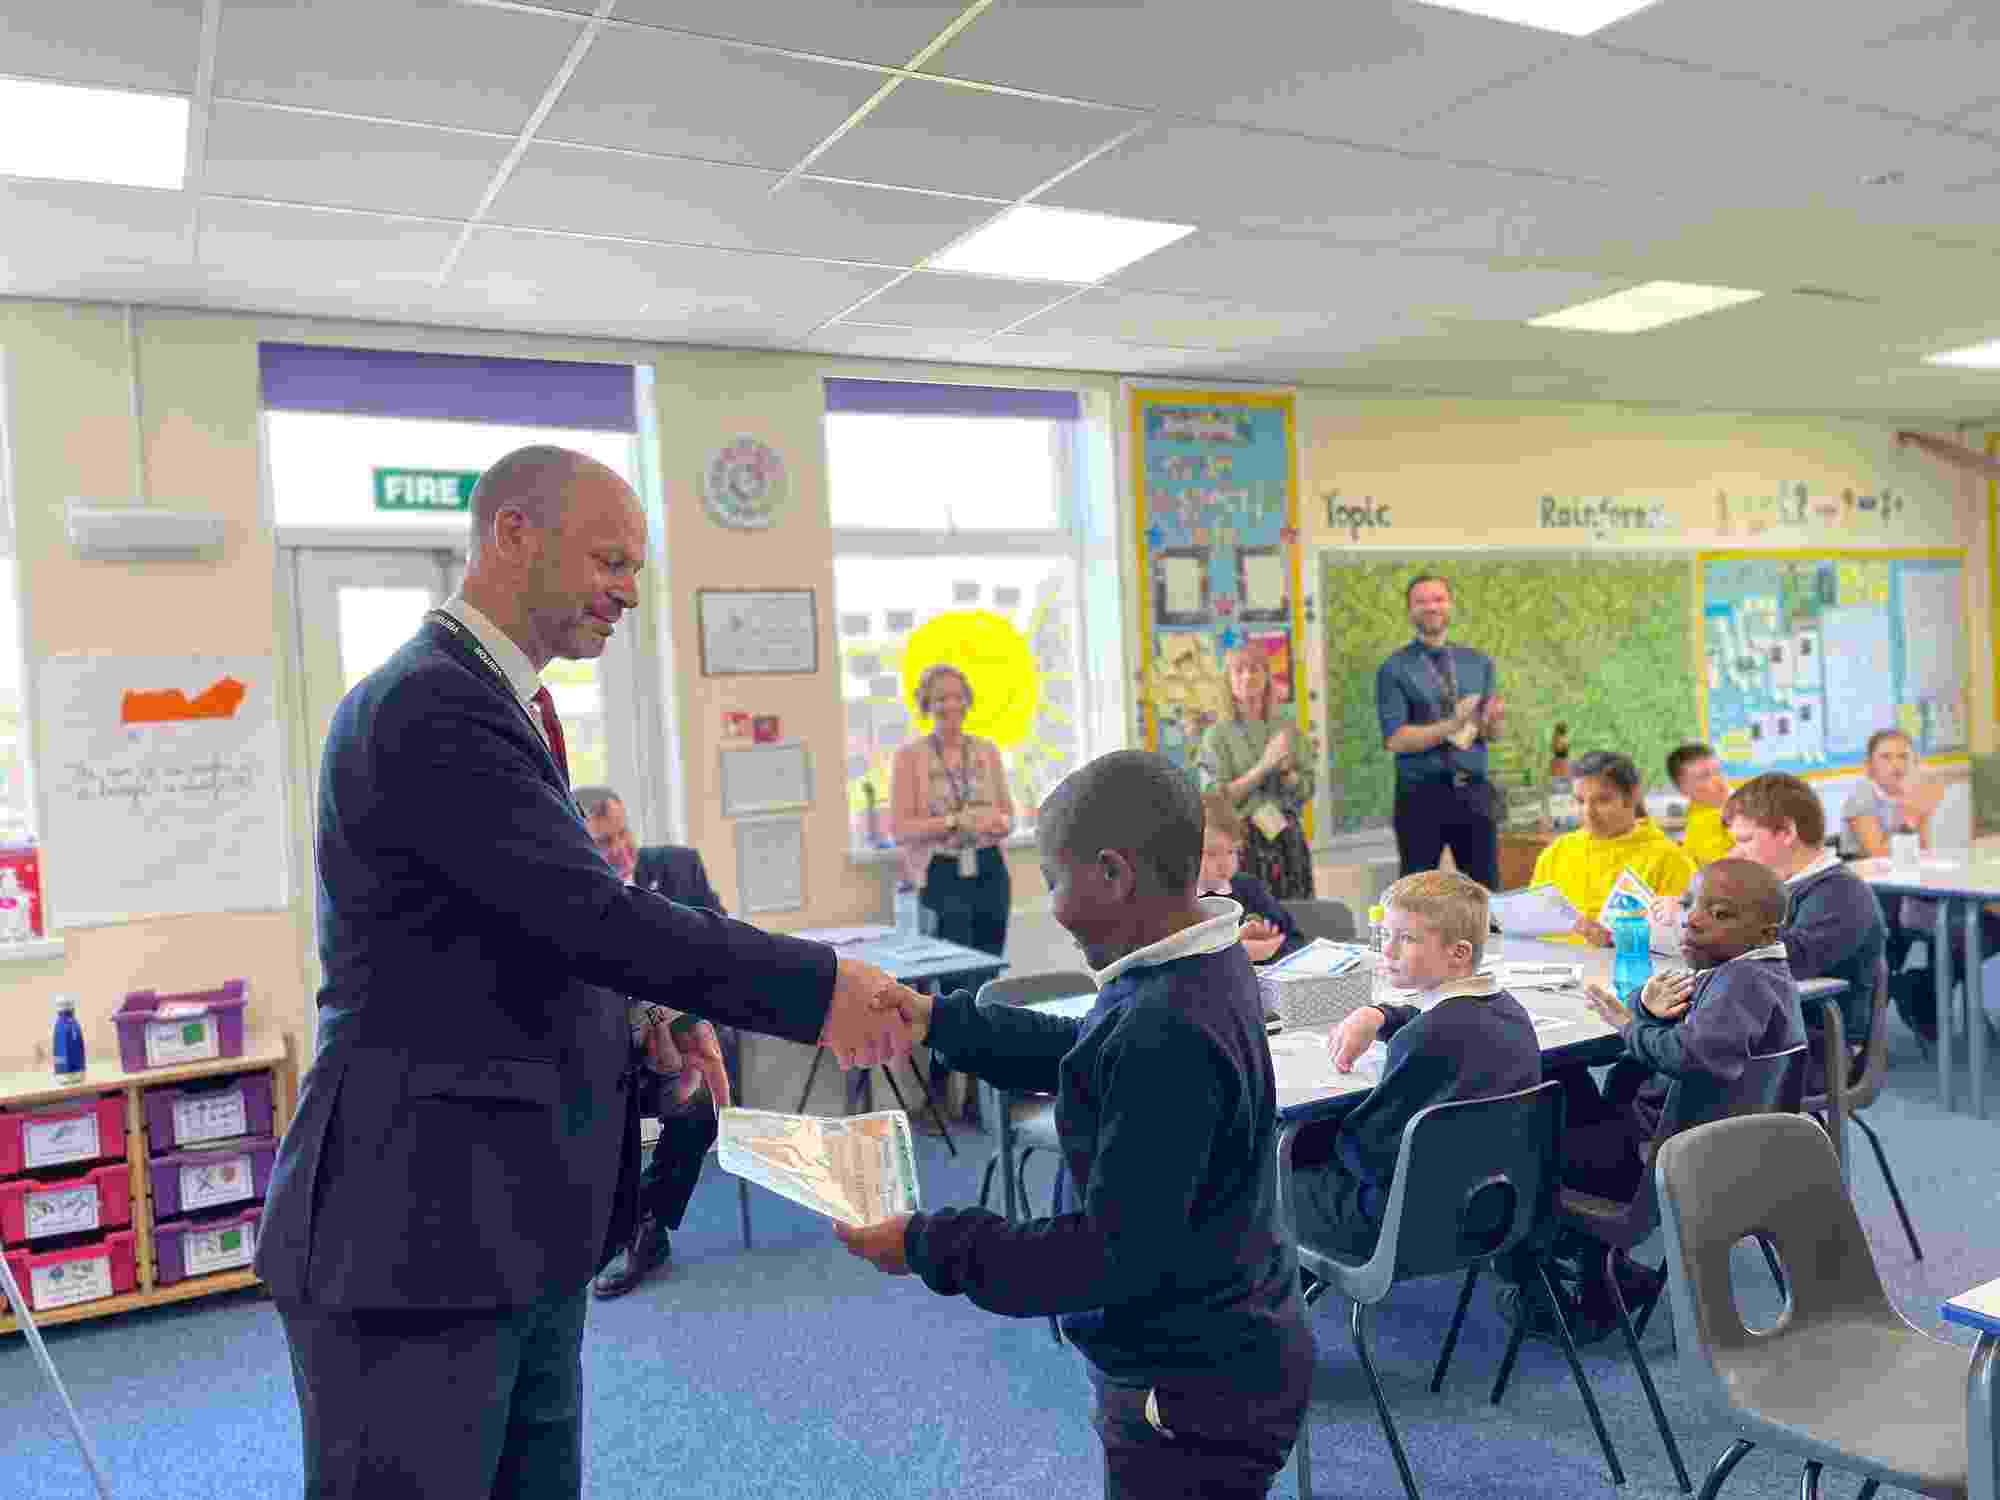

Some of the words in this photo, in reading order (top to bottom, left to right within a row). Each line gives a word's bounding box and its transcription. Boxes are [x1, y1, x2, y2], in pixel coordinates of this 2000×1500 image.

[384, 475, 462, 504] FIRE
[1322, 489, 1392, 543] Topic
[1541, 492, 1670, 540] Rainfore
